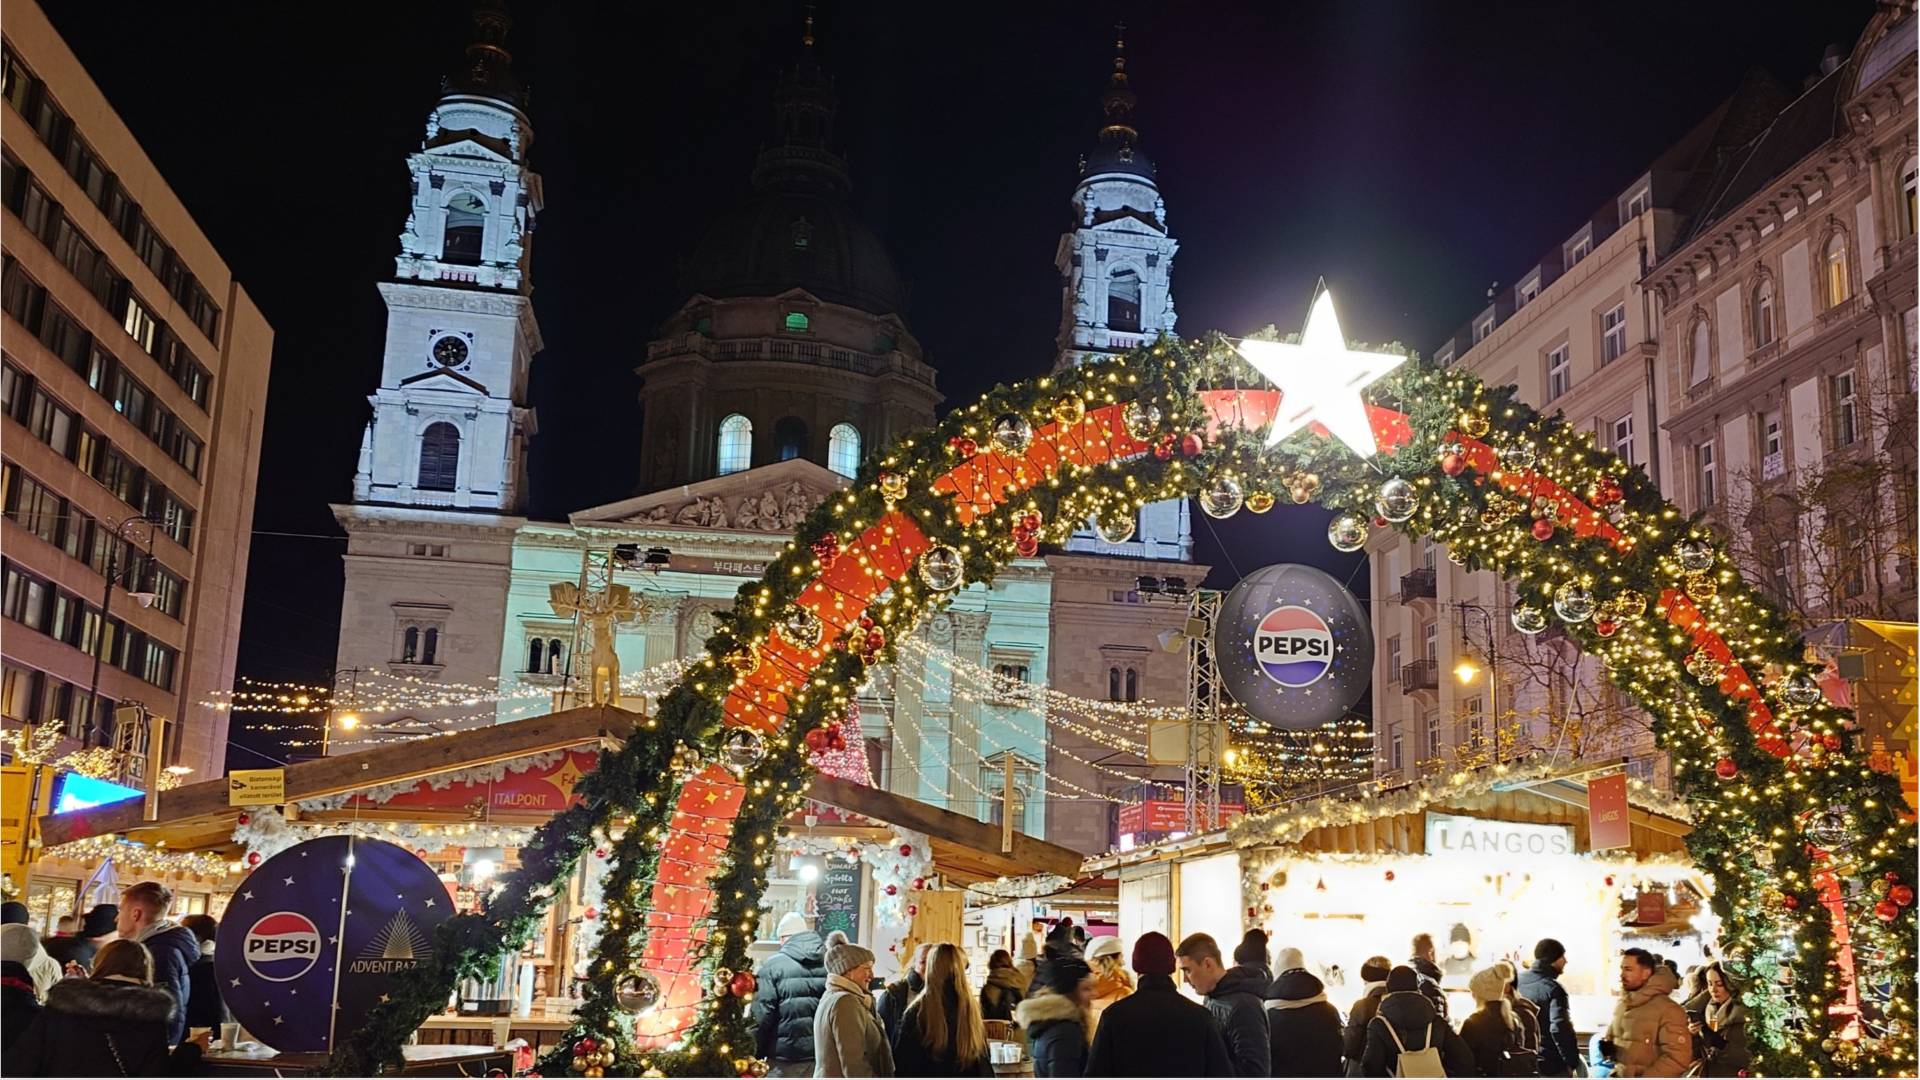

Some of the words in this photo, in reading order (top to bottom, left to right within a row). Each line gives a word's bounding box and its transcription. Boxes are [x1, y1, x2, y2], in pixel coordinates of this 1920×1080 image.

[1258, 636, 1329, 656] PEPSI
[561, 773, 576, 786] F4
[494, 793, 547, 806] ITALPONT
[249, 939, 316, 954] PEPSI
[348, 960, 393, 974] ADVENT
